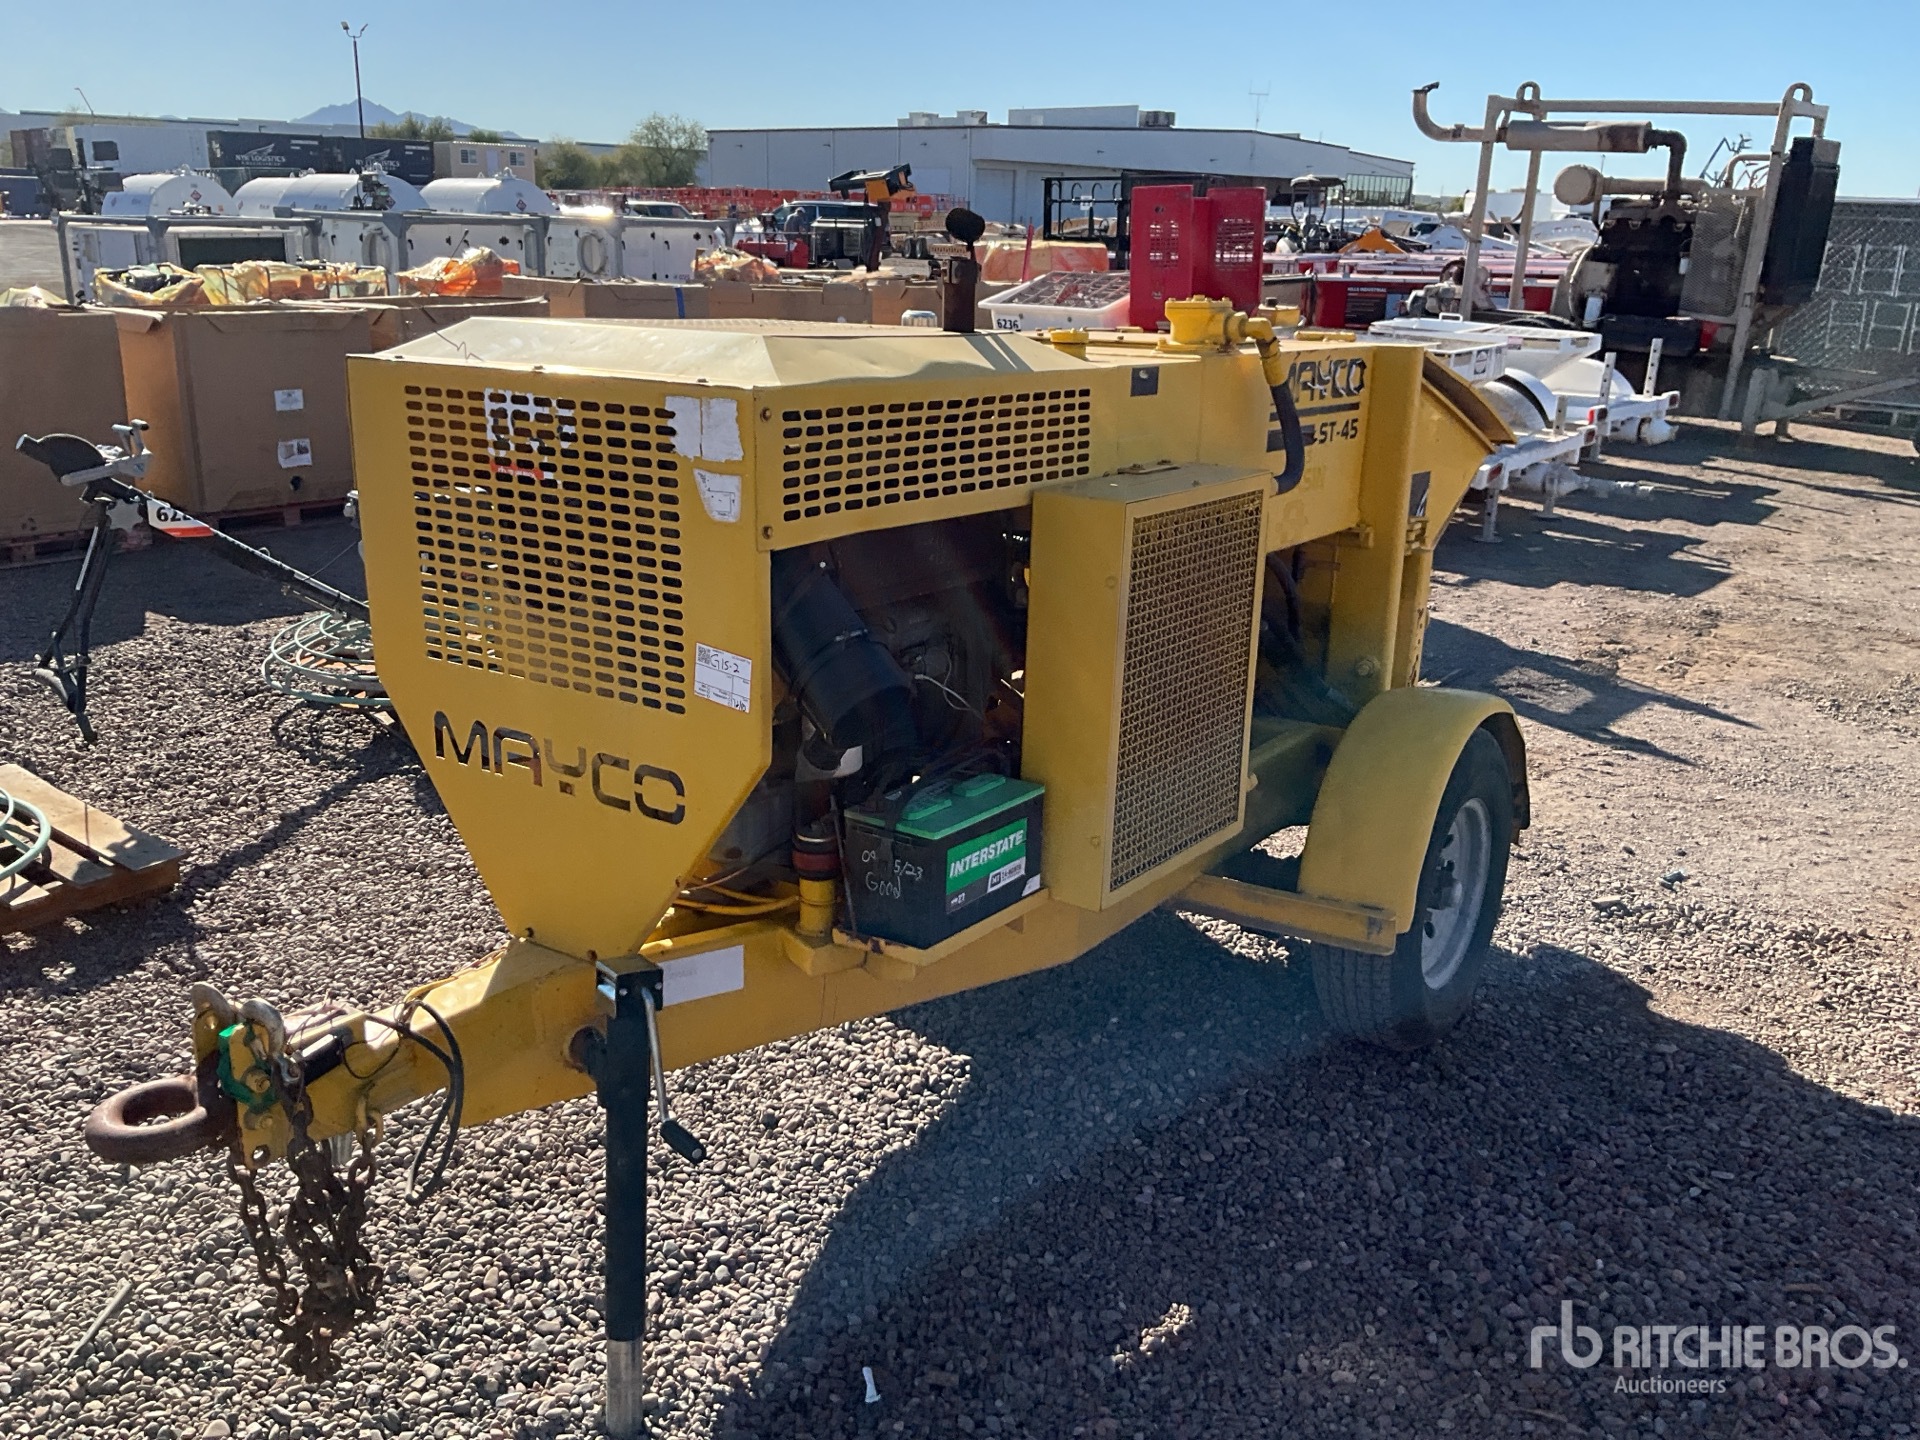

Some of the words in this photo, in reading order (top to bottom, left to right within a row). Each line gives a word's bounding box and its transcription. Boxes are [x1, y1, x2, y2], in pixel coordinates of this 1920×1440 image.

[996, 318, 1019, 330] 6236
[1318, 418, 1359, 445] ST-45
[434, 710, 686, 825] MAYCO
[949, 829, 1024, 879] INTERSTATE
